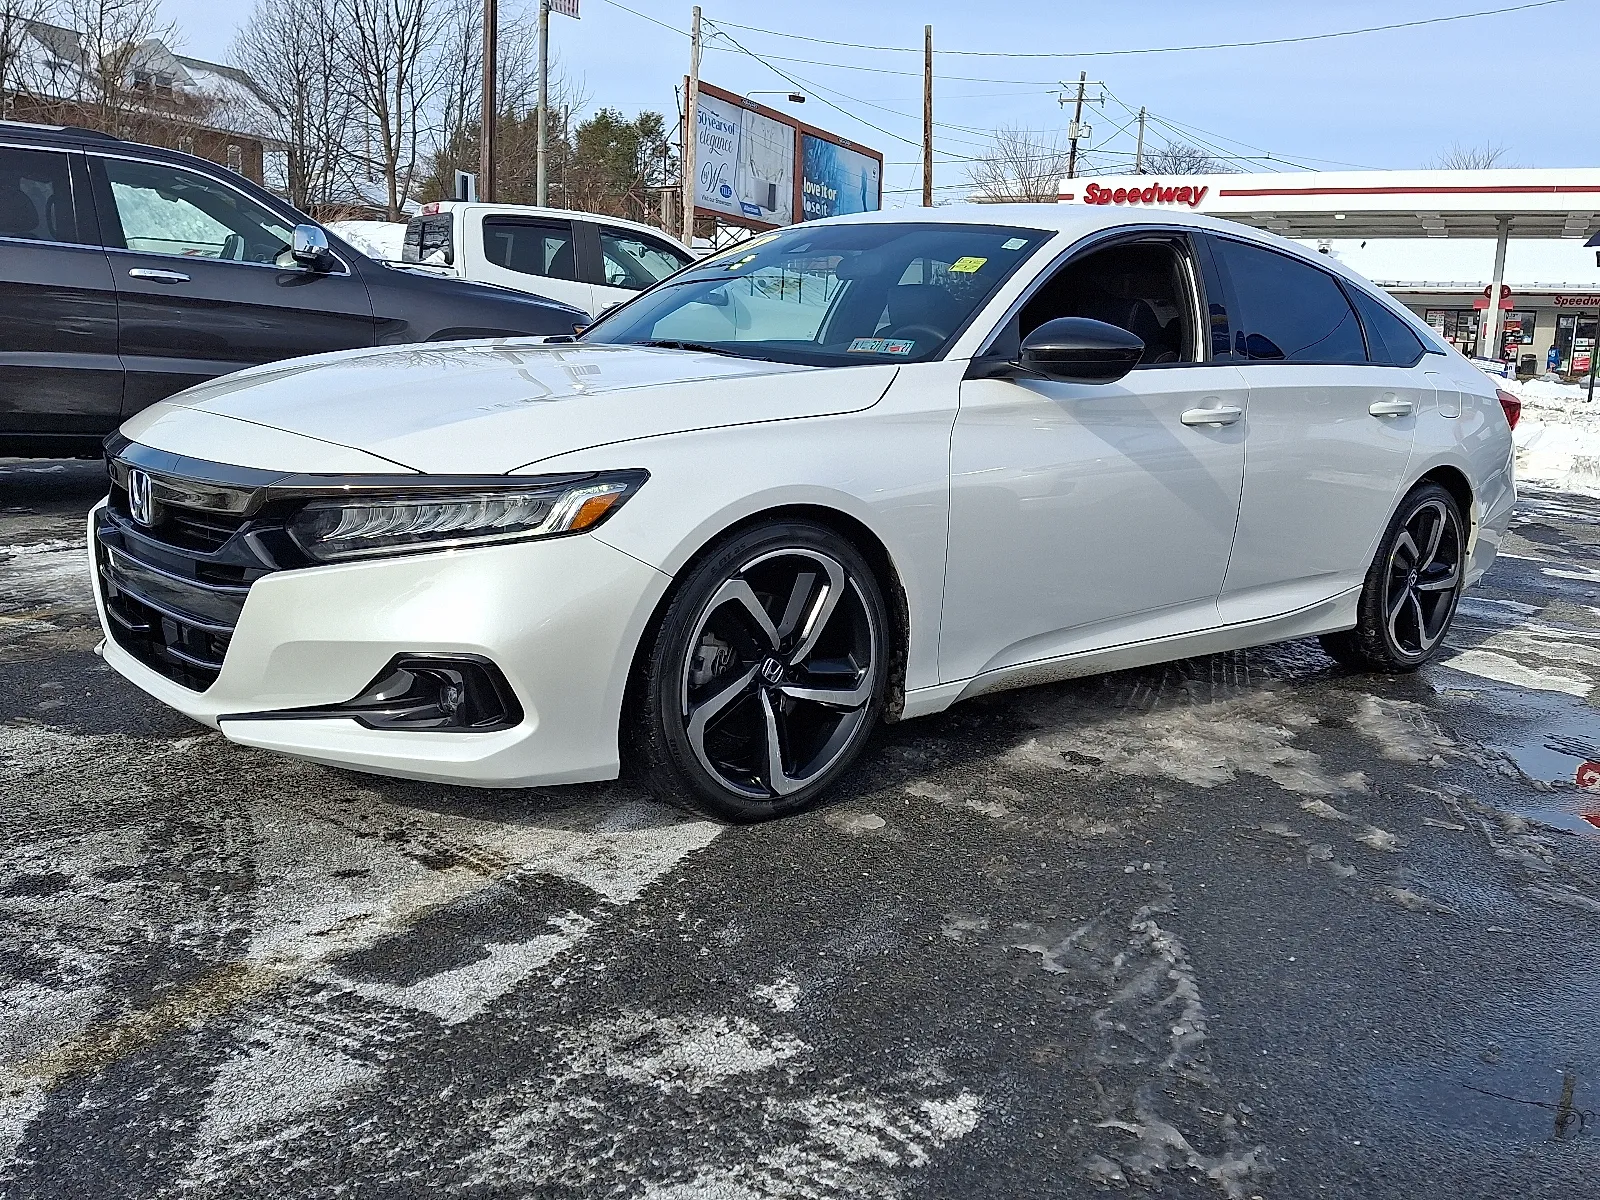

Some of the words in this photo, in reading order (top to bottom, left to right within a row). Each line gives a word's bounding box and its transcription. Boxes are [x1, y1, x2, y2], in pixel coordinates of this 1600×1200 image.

[707, 115, 728, 132] years
[728, 122, 736, 135] of
[700, 126, 733, 157] elegance
[803, 176, 820, 196] love
[821, 181, 828, 199] it
[828, 188, 837, 201] or
[1083, 182, 1209, 208] Speedway
[803, 196, 820, 215] lose
[821, 200, 828, 216] it
